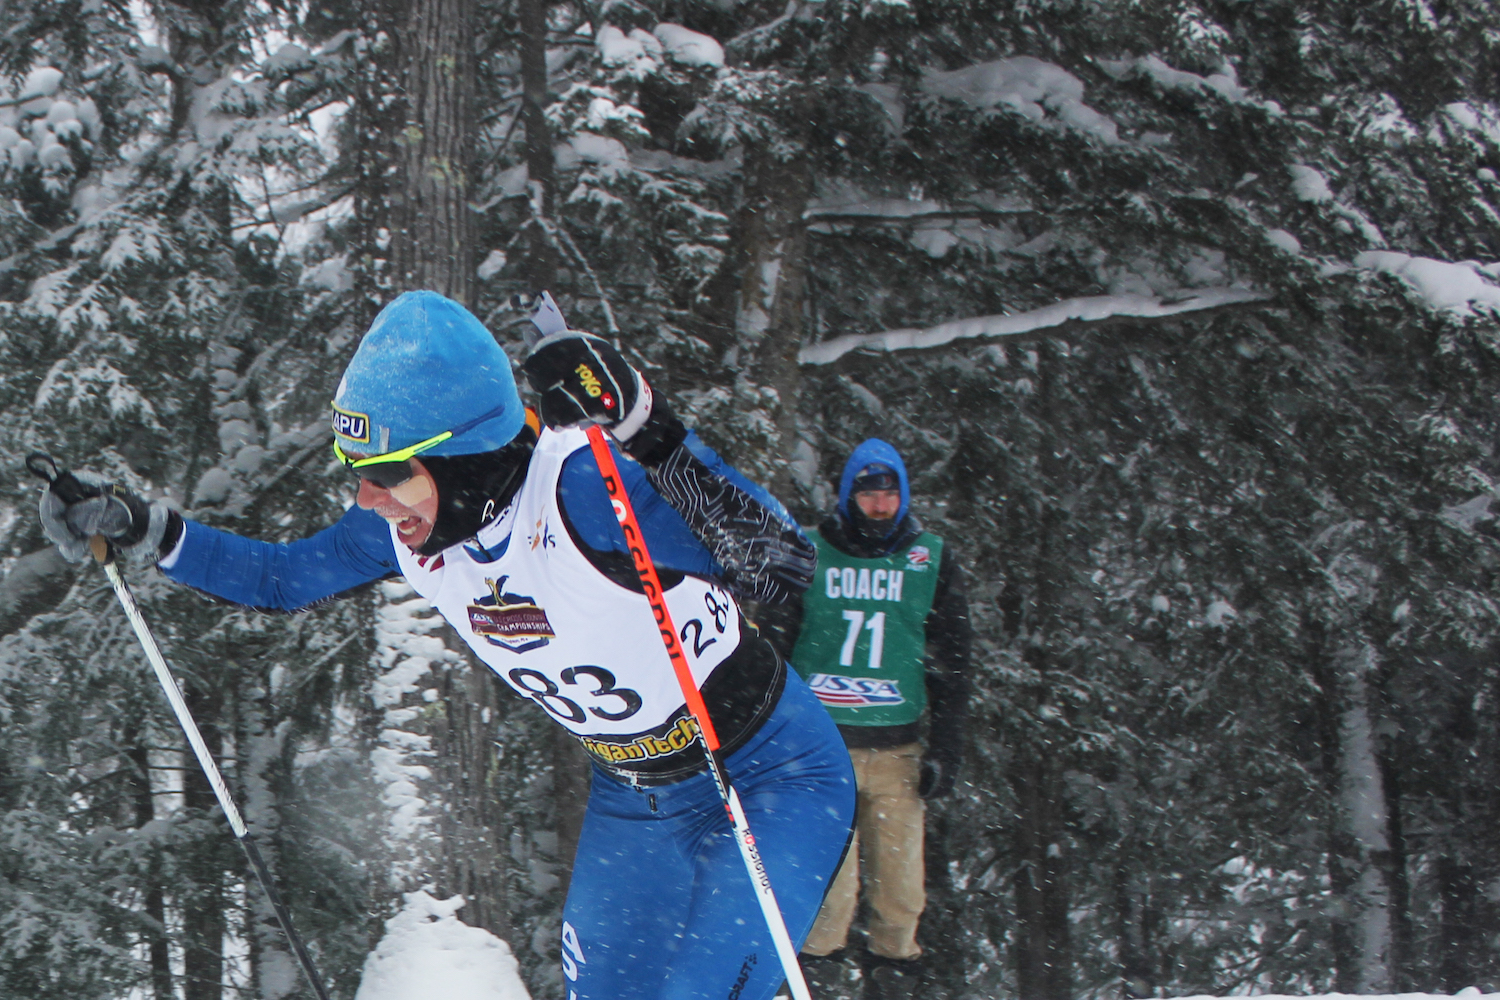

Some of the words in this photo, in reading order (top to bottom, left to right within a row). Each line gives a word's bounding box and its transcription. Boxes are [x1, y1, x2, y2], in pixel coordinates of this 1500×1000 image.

[333, 412, 365, 437] APU
[825, 567, 904, 602] COACH
[497, 622, 551, 632] CHAMPIONSHIPS
[839, 609, 886, 669] 71
[509, 665, 643, 723] 83
[809, 674, 900, 695] USSA
[742, 828, 772, 895] ROSSIGNOL
